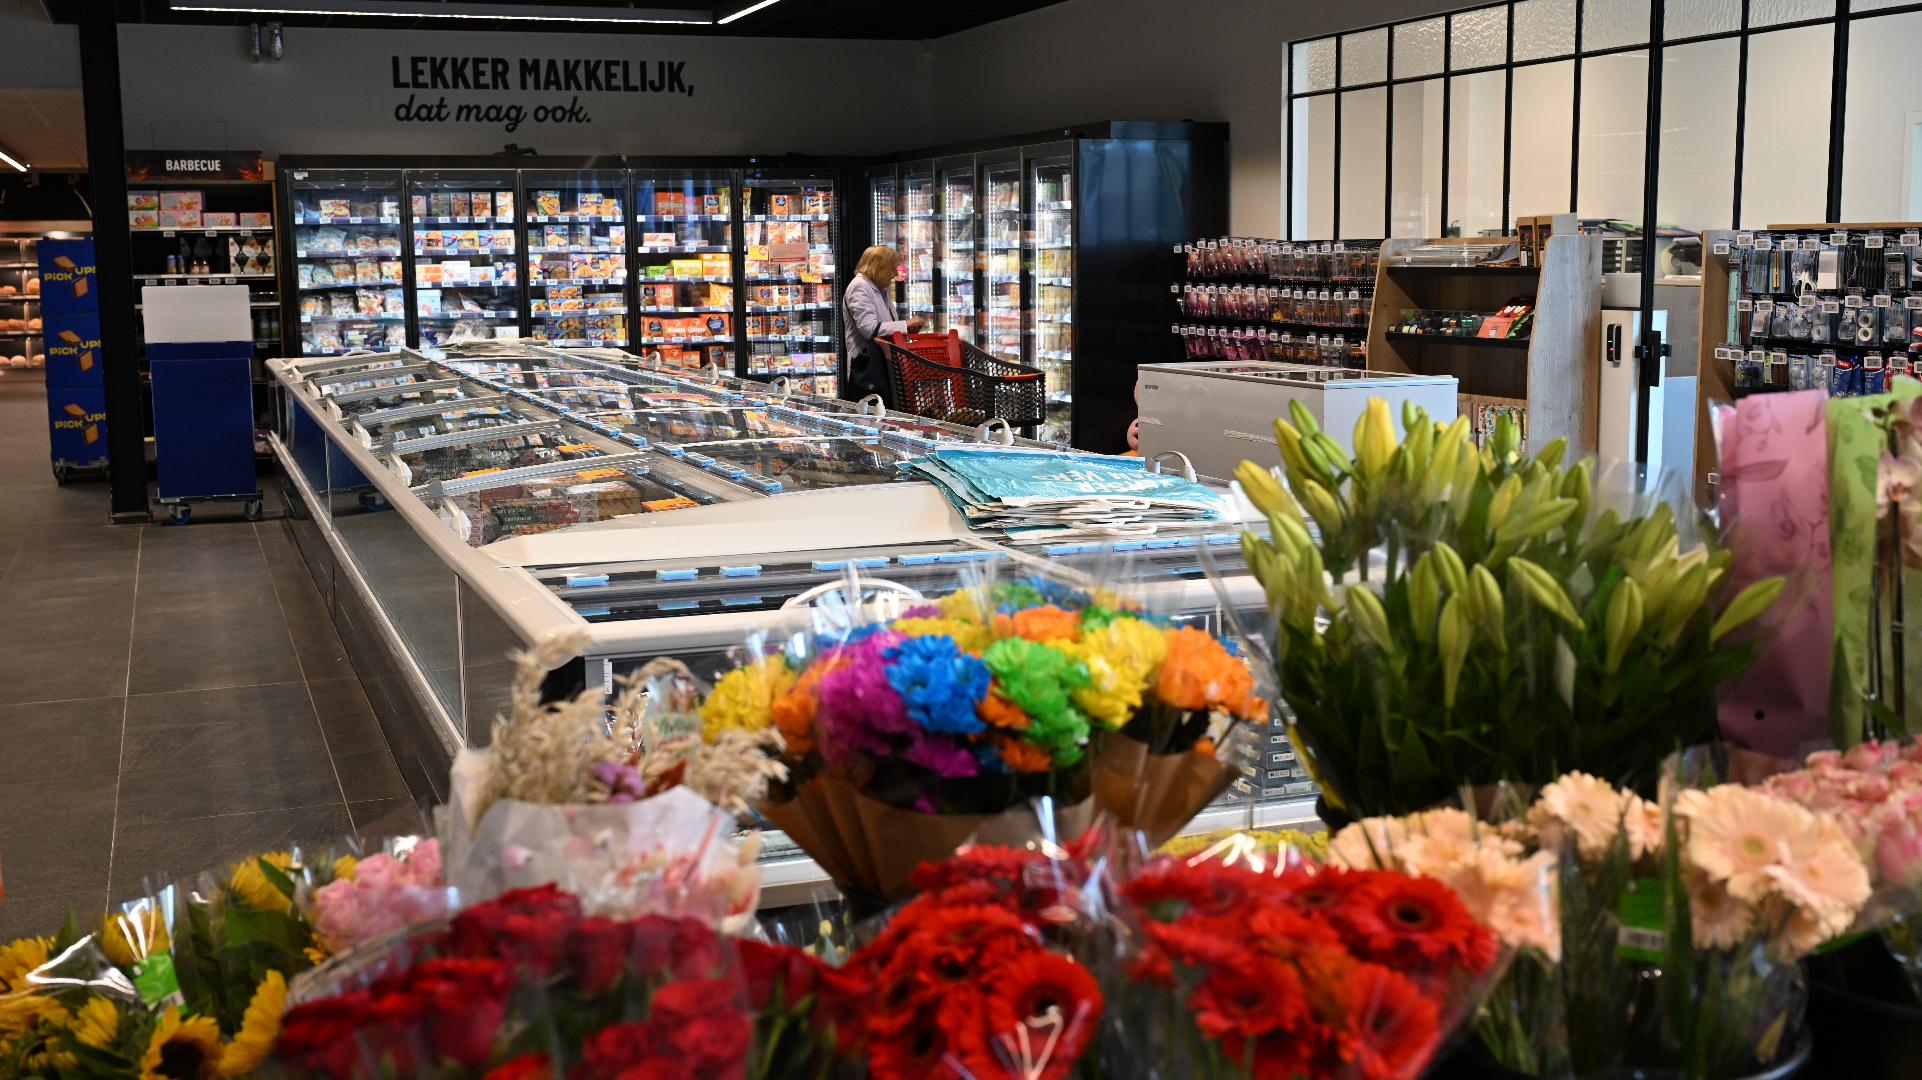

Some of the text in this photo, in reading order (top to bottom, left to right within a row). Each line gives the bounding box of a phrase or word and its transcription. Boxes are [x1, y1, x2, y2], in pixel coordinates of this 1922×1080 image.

[392, 55, 695, 97] LEKKER MAKKELIJK,
[394, 94, 592, 133] dat mag ook.
[165, 159, 221, 172] BARBECUE
[75, 266, 96, 275] UP!
[80, 339, 101, 349] UP!
[85, 412, 106, 422] UP!
